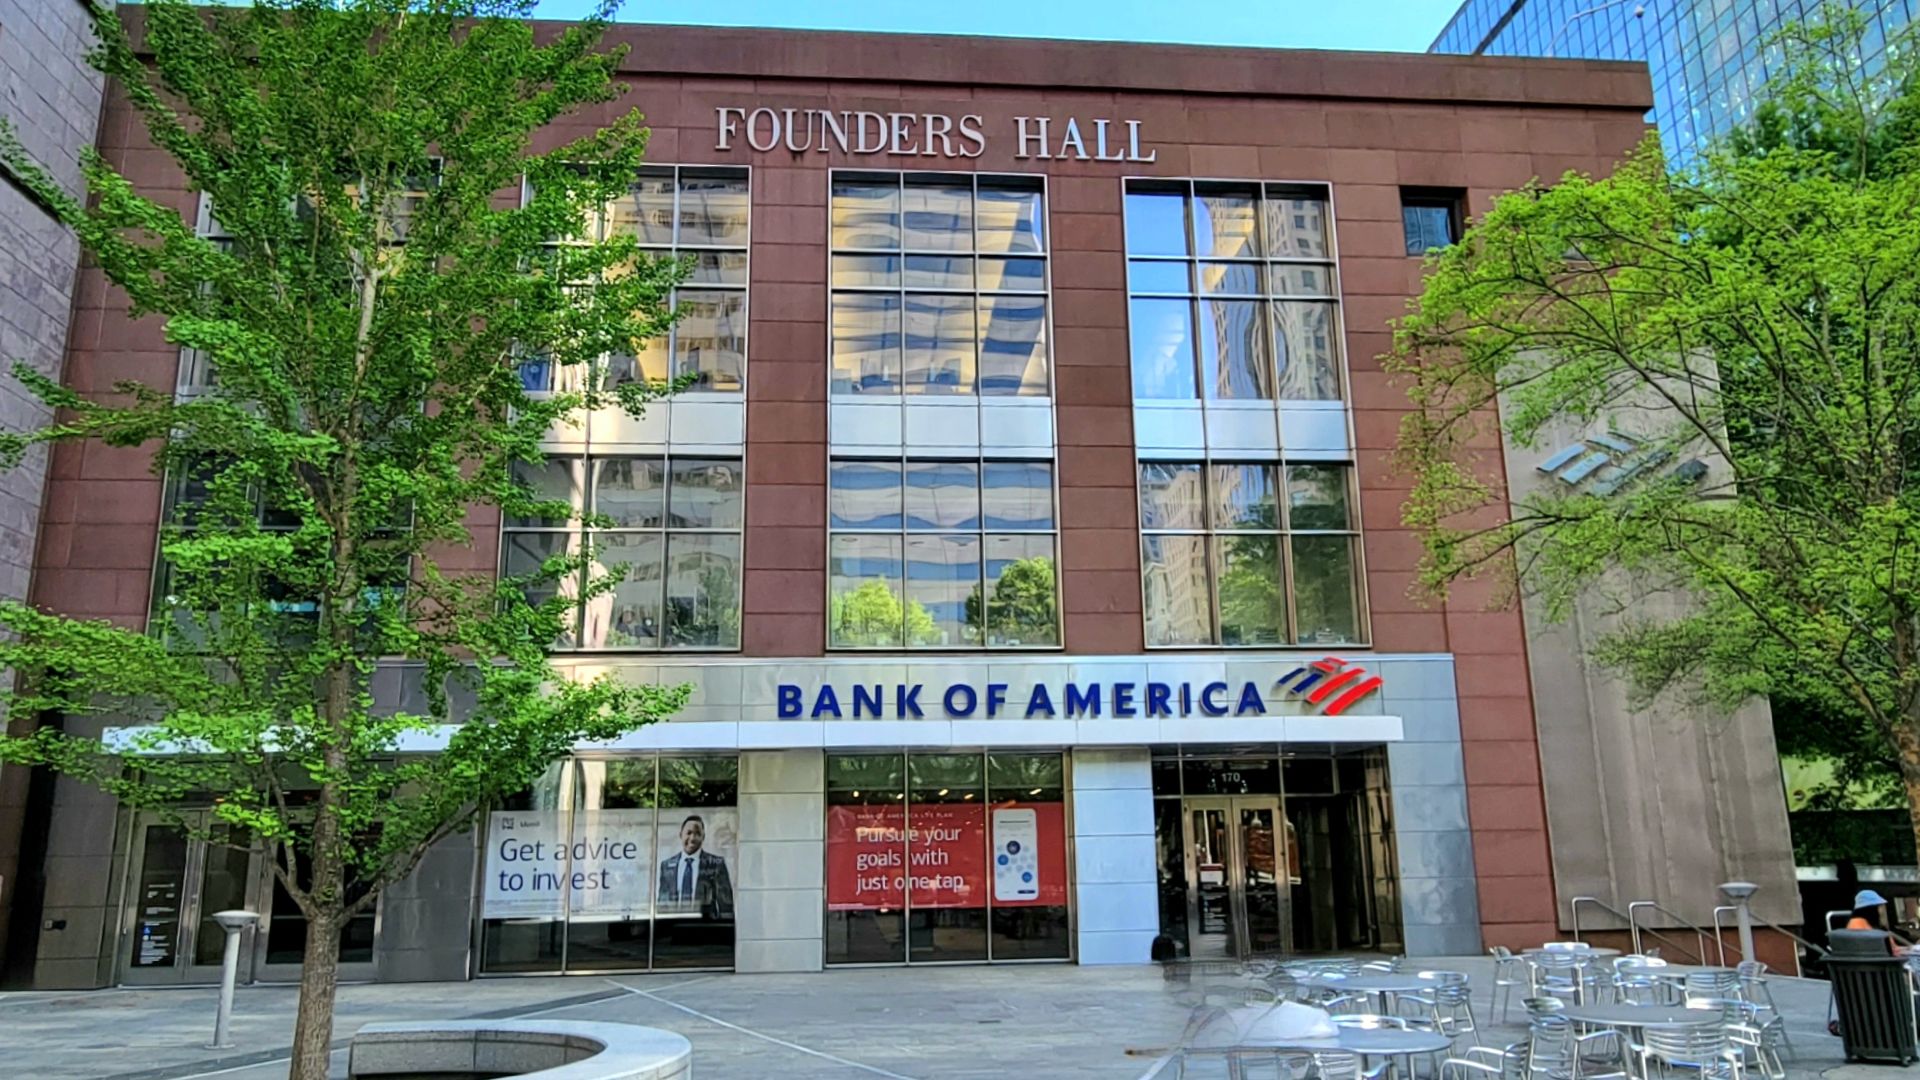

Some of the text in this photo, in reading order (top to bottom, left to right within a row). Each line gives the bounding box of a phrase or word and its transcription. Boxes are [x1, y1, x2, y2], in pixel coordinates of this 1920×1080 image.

[715, 107, 1156, 162] FOUNDERS HALL
[778, 681, 1267, 718] BANK OF AMERICA
[1221, 772, 1241, 783] 170
[856, 826, 962, 846] Pursue your
[500, 837, 637, 861] Get advice
[856, 848, 948, 871] goals with
[499, 868, 610, 891] to invest
[856, 874, 964, 896] just one tap
